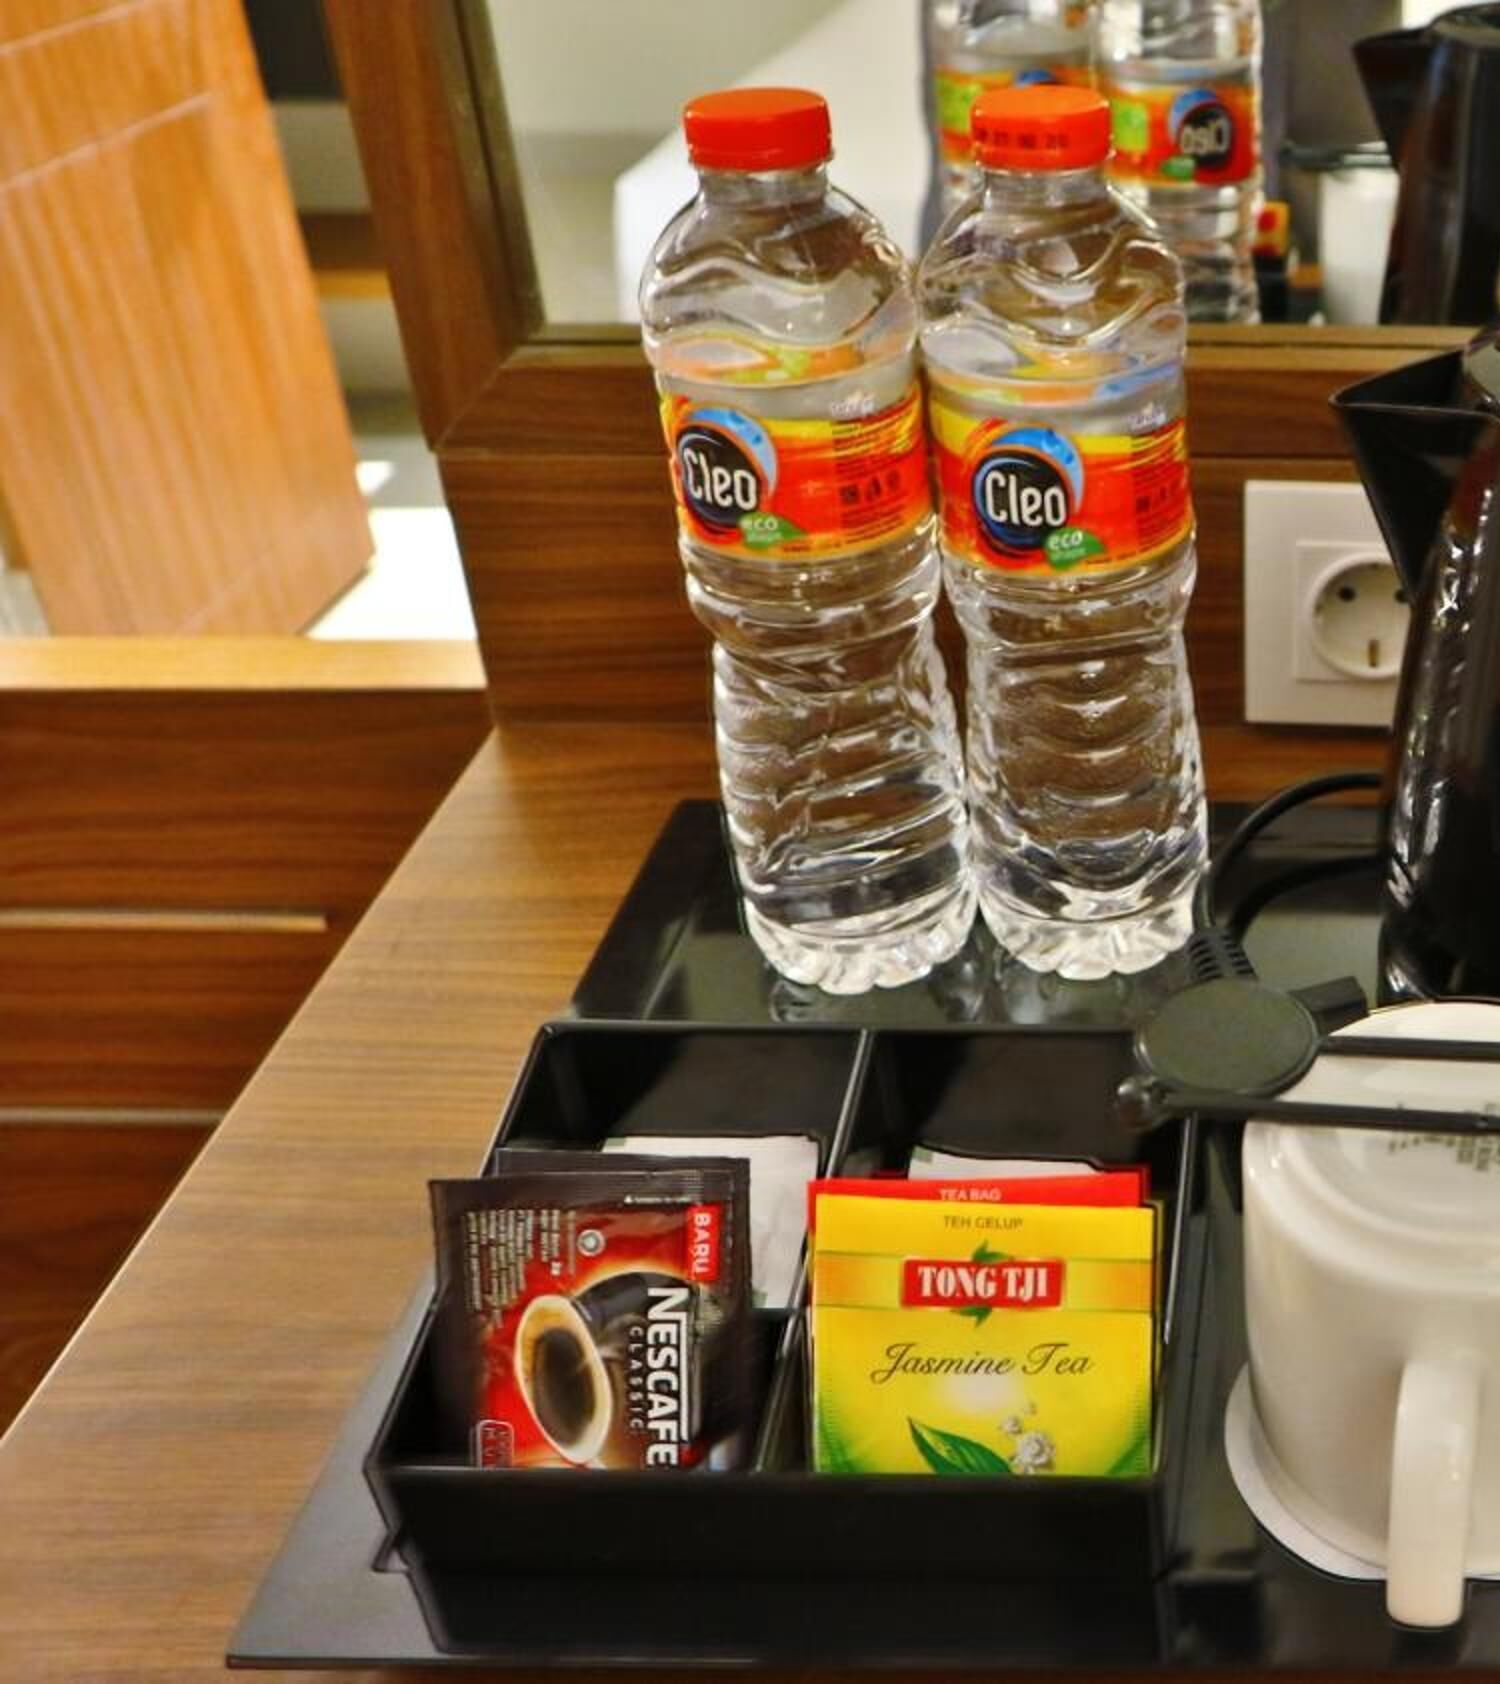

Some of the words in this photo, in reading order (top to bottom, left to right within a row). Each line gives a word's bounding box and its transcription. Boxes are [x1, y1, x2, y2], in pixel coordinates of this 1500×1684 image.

[683, 447, 757, 511] Cleo
[984, 469, 1067, 527] Cleo
[1050, 530, 1084, 551] eco
[939, 1188, 967, 1201] TEA
[969, 1187, 1002, 1202] BAG
[693, 1212, 712, 1274] BARU
[943, 1215, 972, 1229] TEH
[917, 1265, 998, 1299] TONG
[1001, 1266, 1048, 1303] TJI
[629, 1325, 645, 1430] CLASSIC
[869, 1341, 1015, 1386] Jasmine
[1020, 1342, 1094, 1377] Tea
